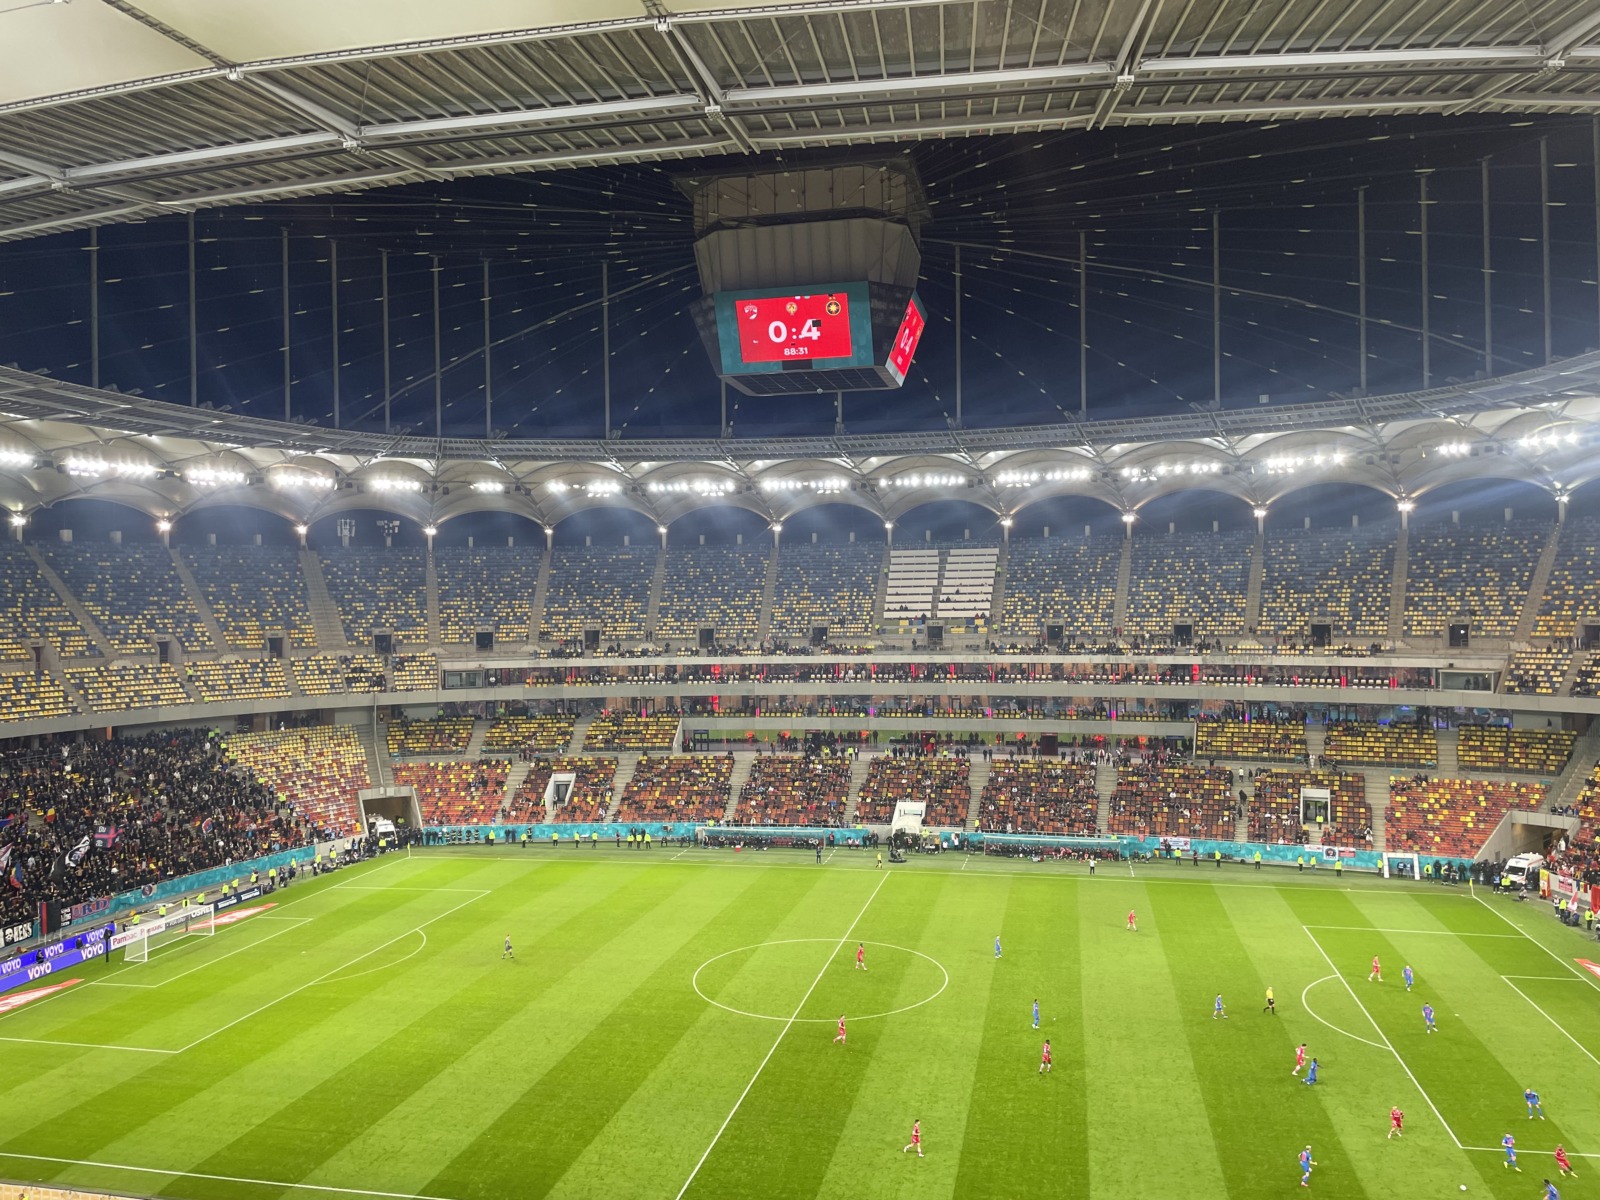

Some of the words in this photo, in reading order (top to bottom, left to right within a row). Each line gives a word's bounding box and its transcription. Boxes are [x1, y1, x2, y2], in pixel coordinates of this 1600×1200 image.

[783, 347, 808, 356] 88:31
[86, 928, 105, 943] VOYO
[112, 931, 138, 946] Pambac
[44, 943, 64, 958] VOYO
[81, 943, 104, 960] VOYO
[1, 958, 21, 974] VOYO
[28, 962, 51, 980] VOYO
